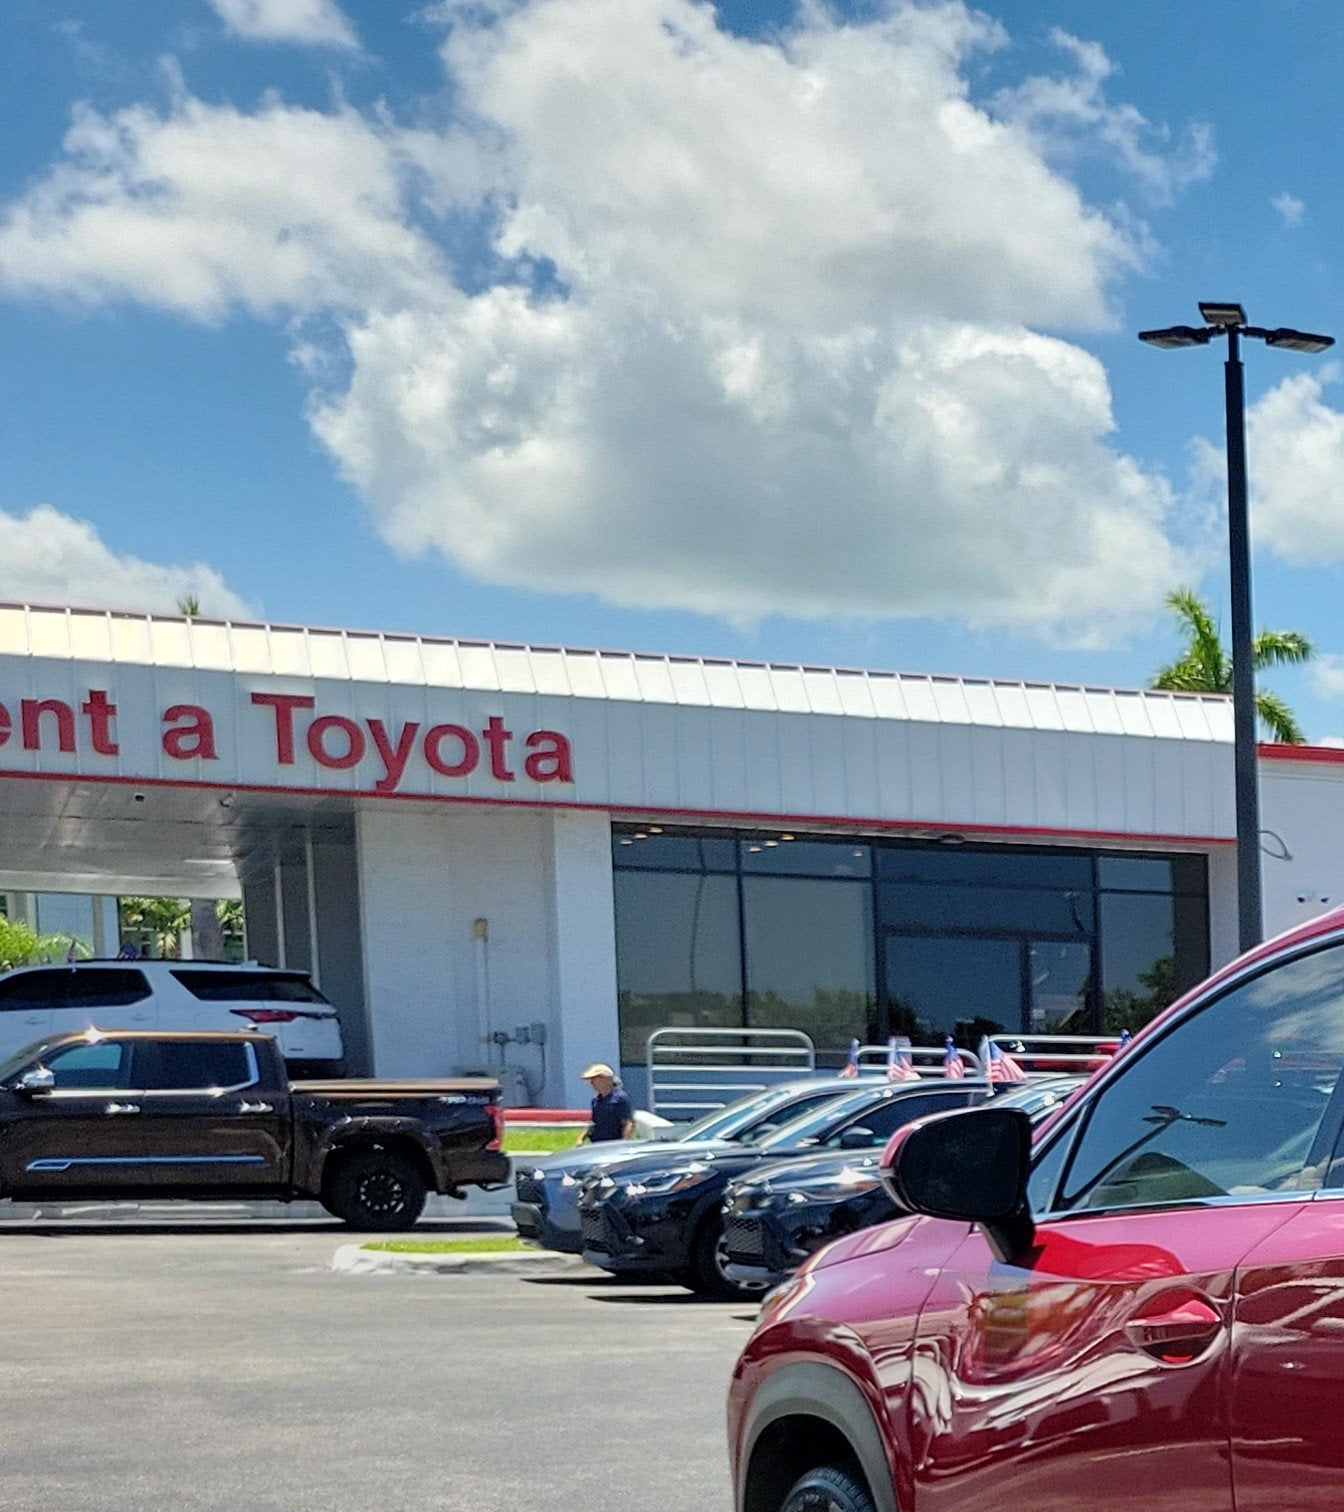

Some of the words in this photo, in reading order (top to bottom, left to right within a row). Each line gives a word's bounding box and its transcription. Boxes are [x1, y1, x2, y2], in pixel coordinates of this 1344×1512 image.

[0, 690, 120, 757] nt
[162, 704, 219, 761] a
[251, 693, 574, 792] Toyota
